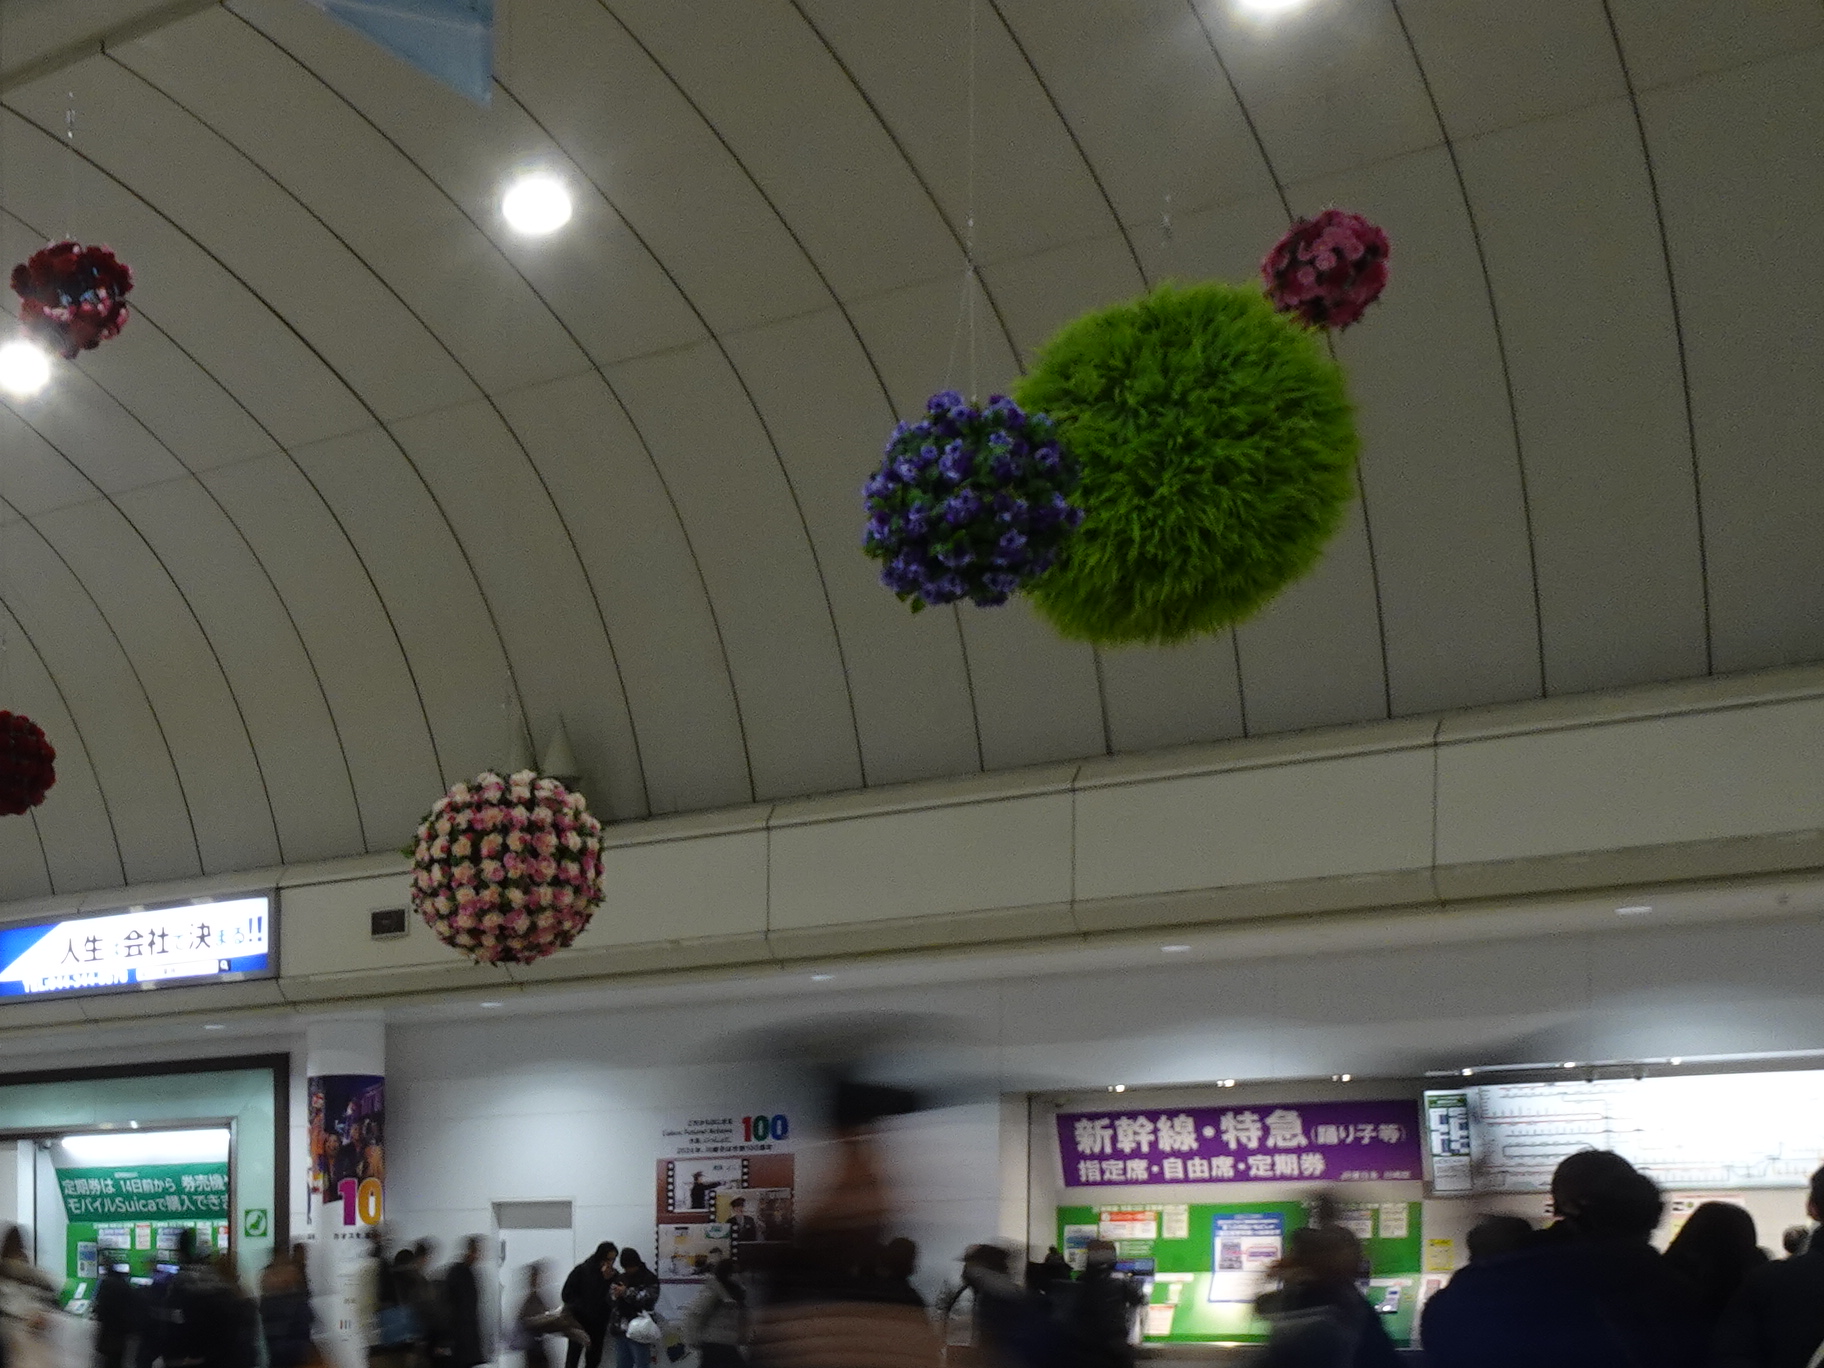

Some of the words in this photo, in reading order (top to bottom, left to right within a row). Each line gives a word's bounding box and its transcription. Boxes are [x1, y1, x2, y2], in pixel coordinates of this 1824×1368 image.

[742, 1114, 789, 1143] 100
[1077, 1152, 1326, 1183] 指定席・自由席・定期券
[61, 1178, 116, 1196] 定期券は
[119, 1178, 177, 1194] 14日前から
[181, 1174, 229, 1192] 券売機
